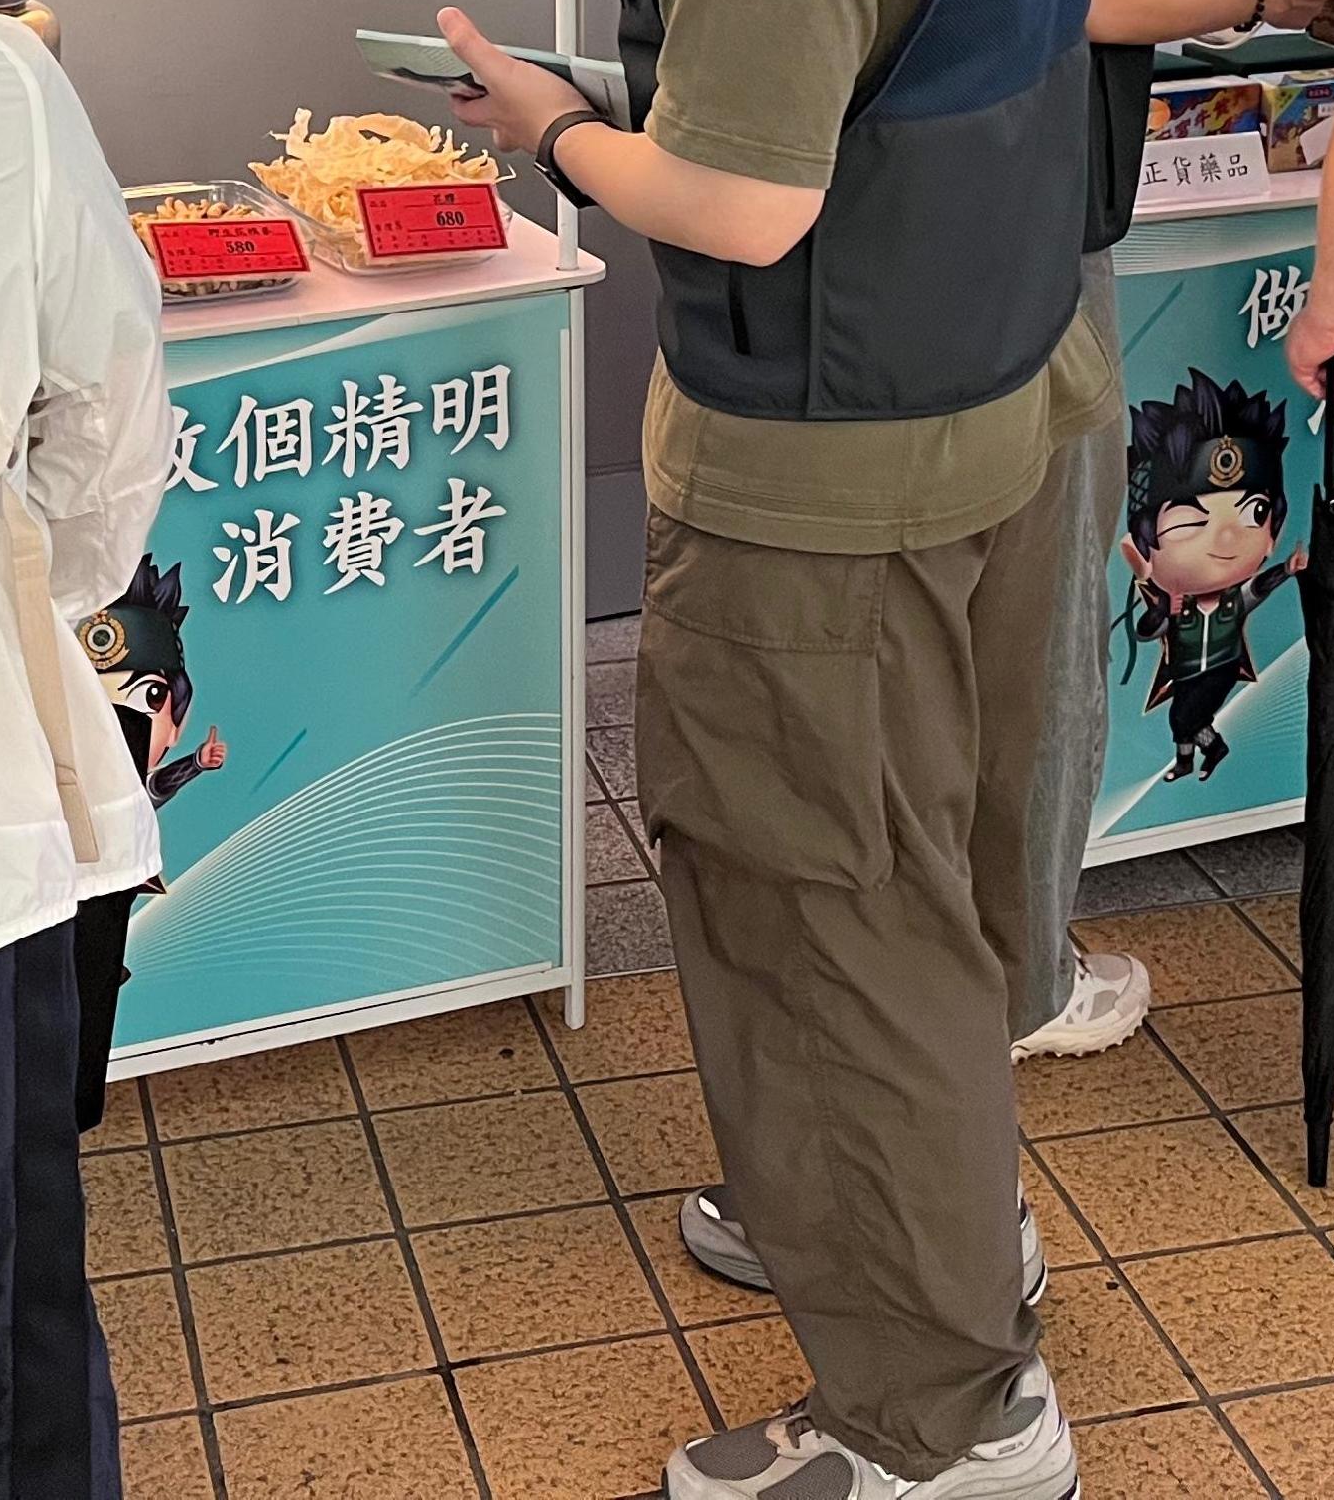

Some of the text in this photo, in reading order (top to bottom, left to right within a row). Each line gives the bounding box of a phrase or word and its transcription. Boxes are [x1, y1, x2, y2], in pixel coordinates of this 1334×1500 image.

[1142, 152, 1248, 187] 正貨藥品
[436, 210, 465, 227] 680
[225, 240, 255, 254] 580
[212, 477, 507, 604] 消費者
